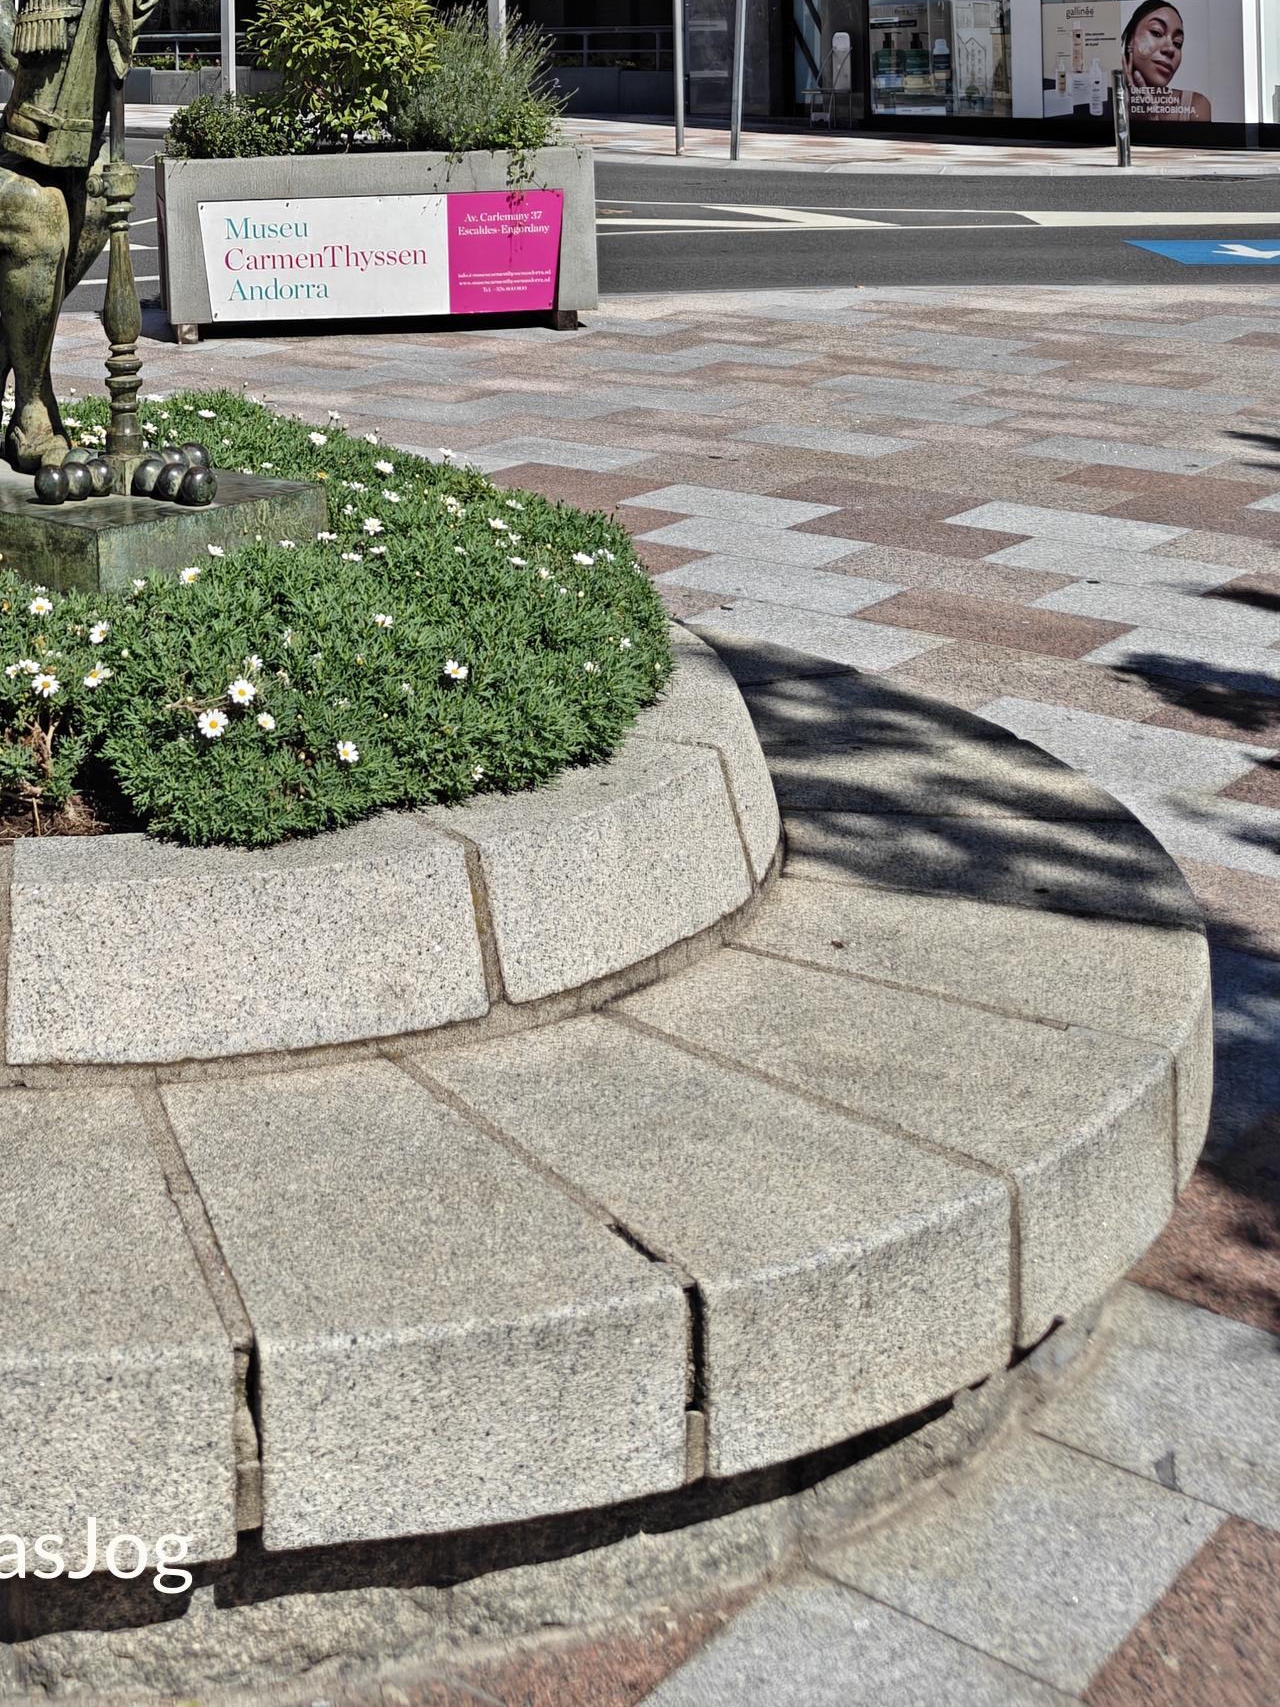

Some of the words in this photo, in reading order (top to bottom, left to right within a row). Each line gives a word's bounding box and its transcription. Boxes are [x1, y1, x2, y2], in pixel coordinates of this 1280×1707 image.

[1130, 95, 1180, 104] REVOLUCIÓN
[1131, 105, 1146, 114] DEL
[1147, 105, 1197, 114] MICROBIOMA
[464, 213, 479, 223] Av.
[480, 211, 530, 223] Carlemany
[531, 210, 542, 220] 37
[225, 216, 309, 240] Museu
[228, 277, 330, 302] Andorra
